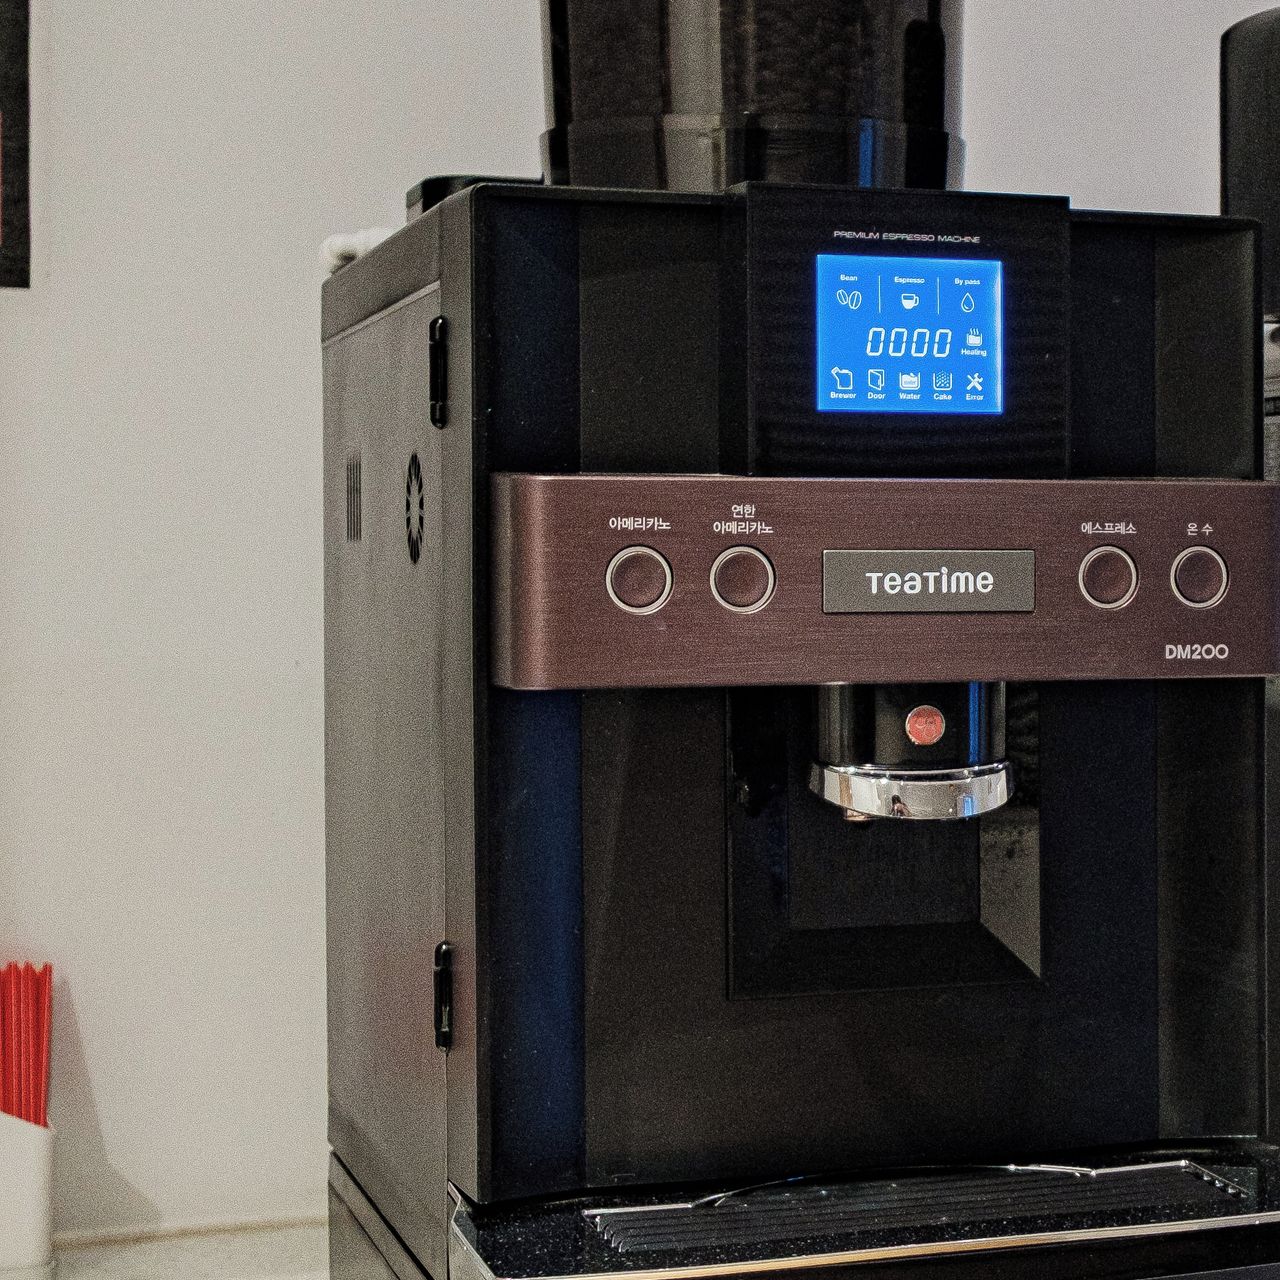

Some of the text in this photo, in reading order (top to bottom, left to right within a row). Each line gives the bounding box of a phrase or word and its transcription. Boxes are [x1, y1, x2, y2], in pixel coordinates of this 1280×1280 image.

[833, 230, 981, 244] PREMIUM ESPRESSO MACHINE
[840, 274, 858, 282] Bean
[894, 276, 925, 285] Espresso
[866, 327, 952, 358] 0000
[961, 348, 987, 357] Heating
[830, 392, 857, 400] Brewer
[867, 392, 886, 400] Door
[899, 393, 921, 401] Water
[933, 393, 952, 401] Cake
[966, 394, 984, 402] Error
[731, 504, 755, 518] 연한
[609, 516, 671, 531] 아메리카노
[713, 520, 773, 535] 아메리카노
[1081, 522, 1137, 535] 에스프레소
[1165, 643, 1229, 660] DM200
